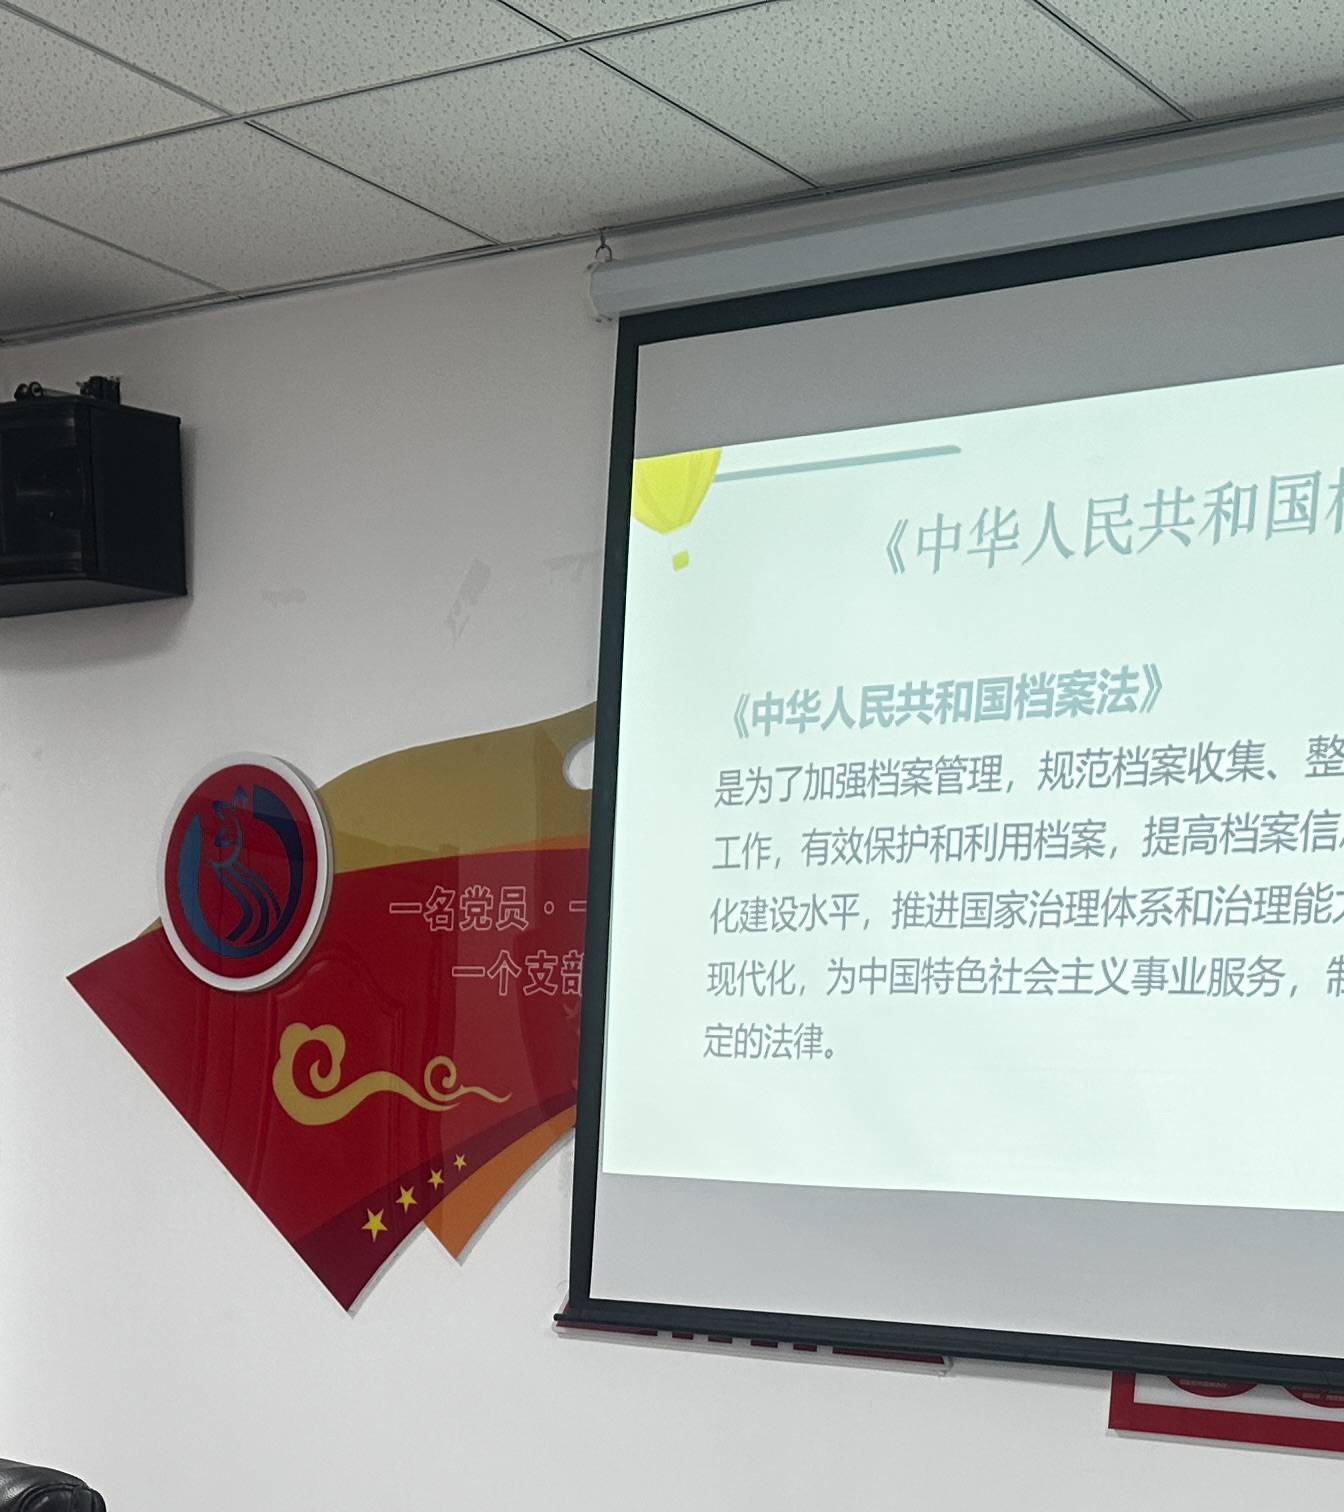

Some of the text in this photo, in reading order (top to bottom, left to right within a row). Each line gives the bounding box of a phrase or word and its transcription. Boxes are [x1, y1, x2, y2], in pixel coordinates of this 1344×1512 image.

[732, 663, 1164, 738] 《中华人民共和国档案法》
[703, 1024, 837, 1061] 定的法律。
